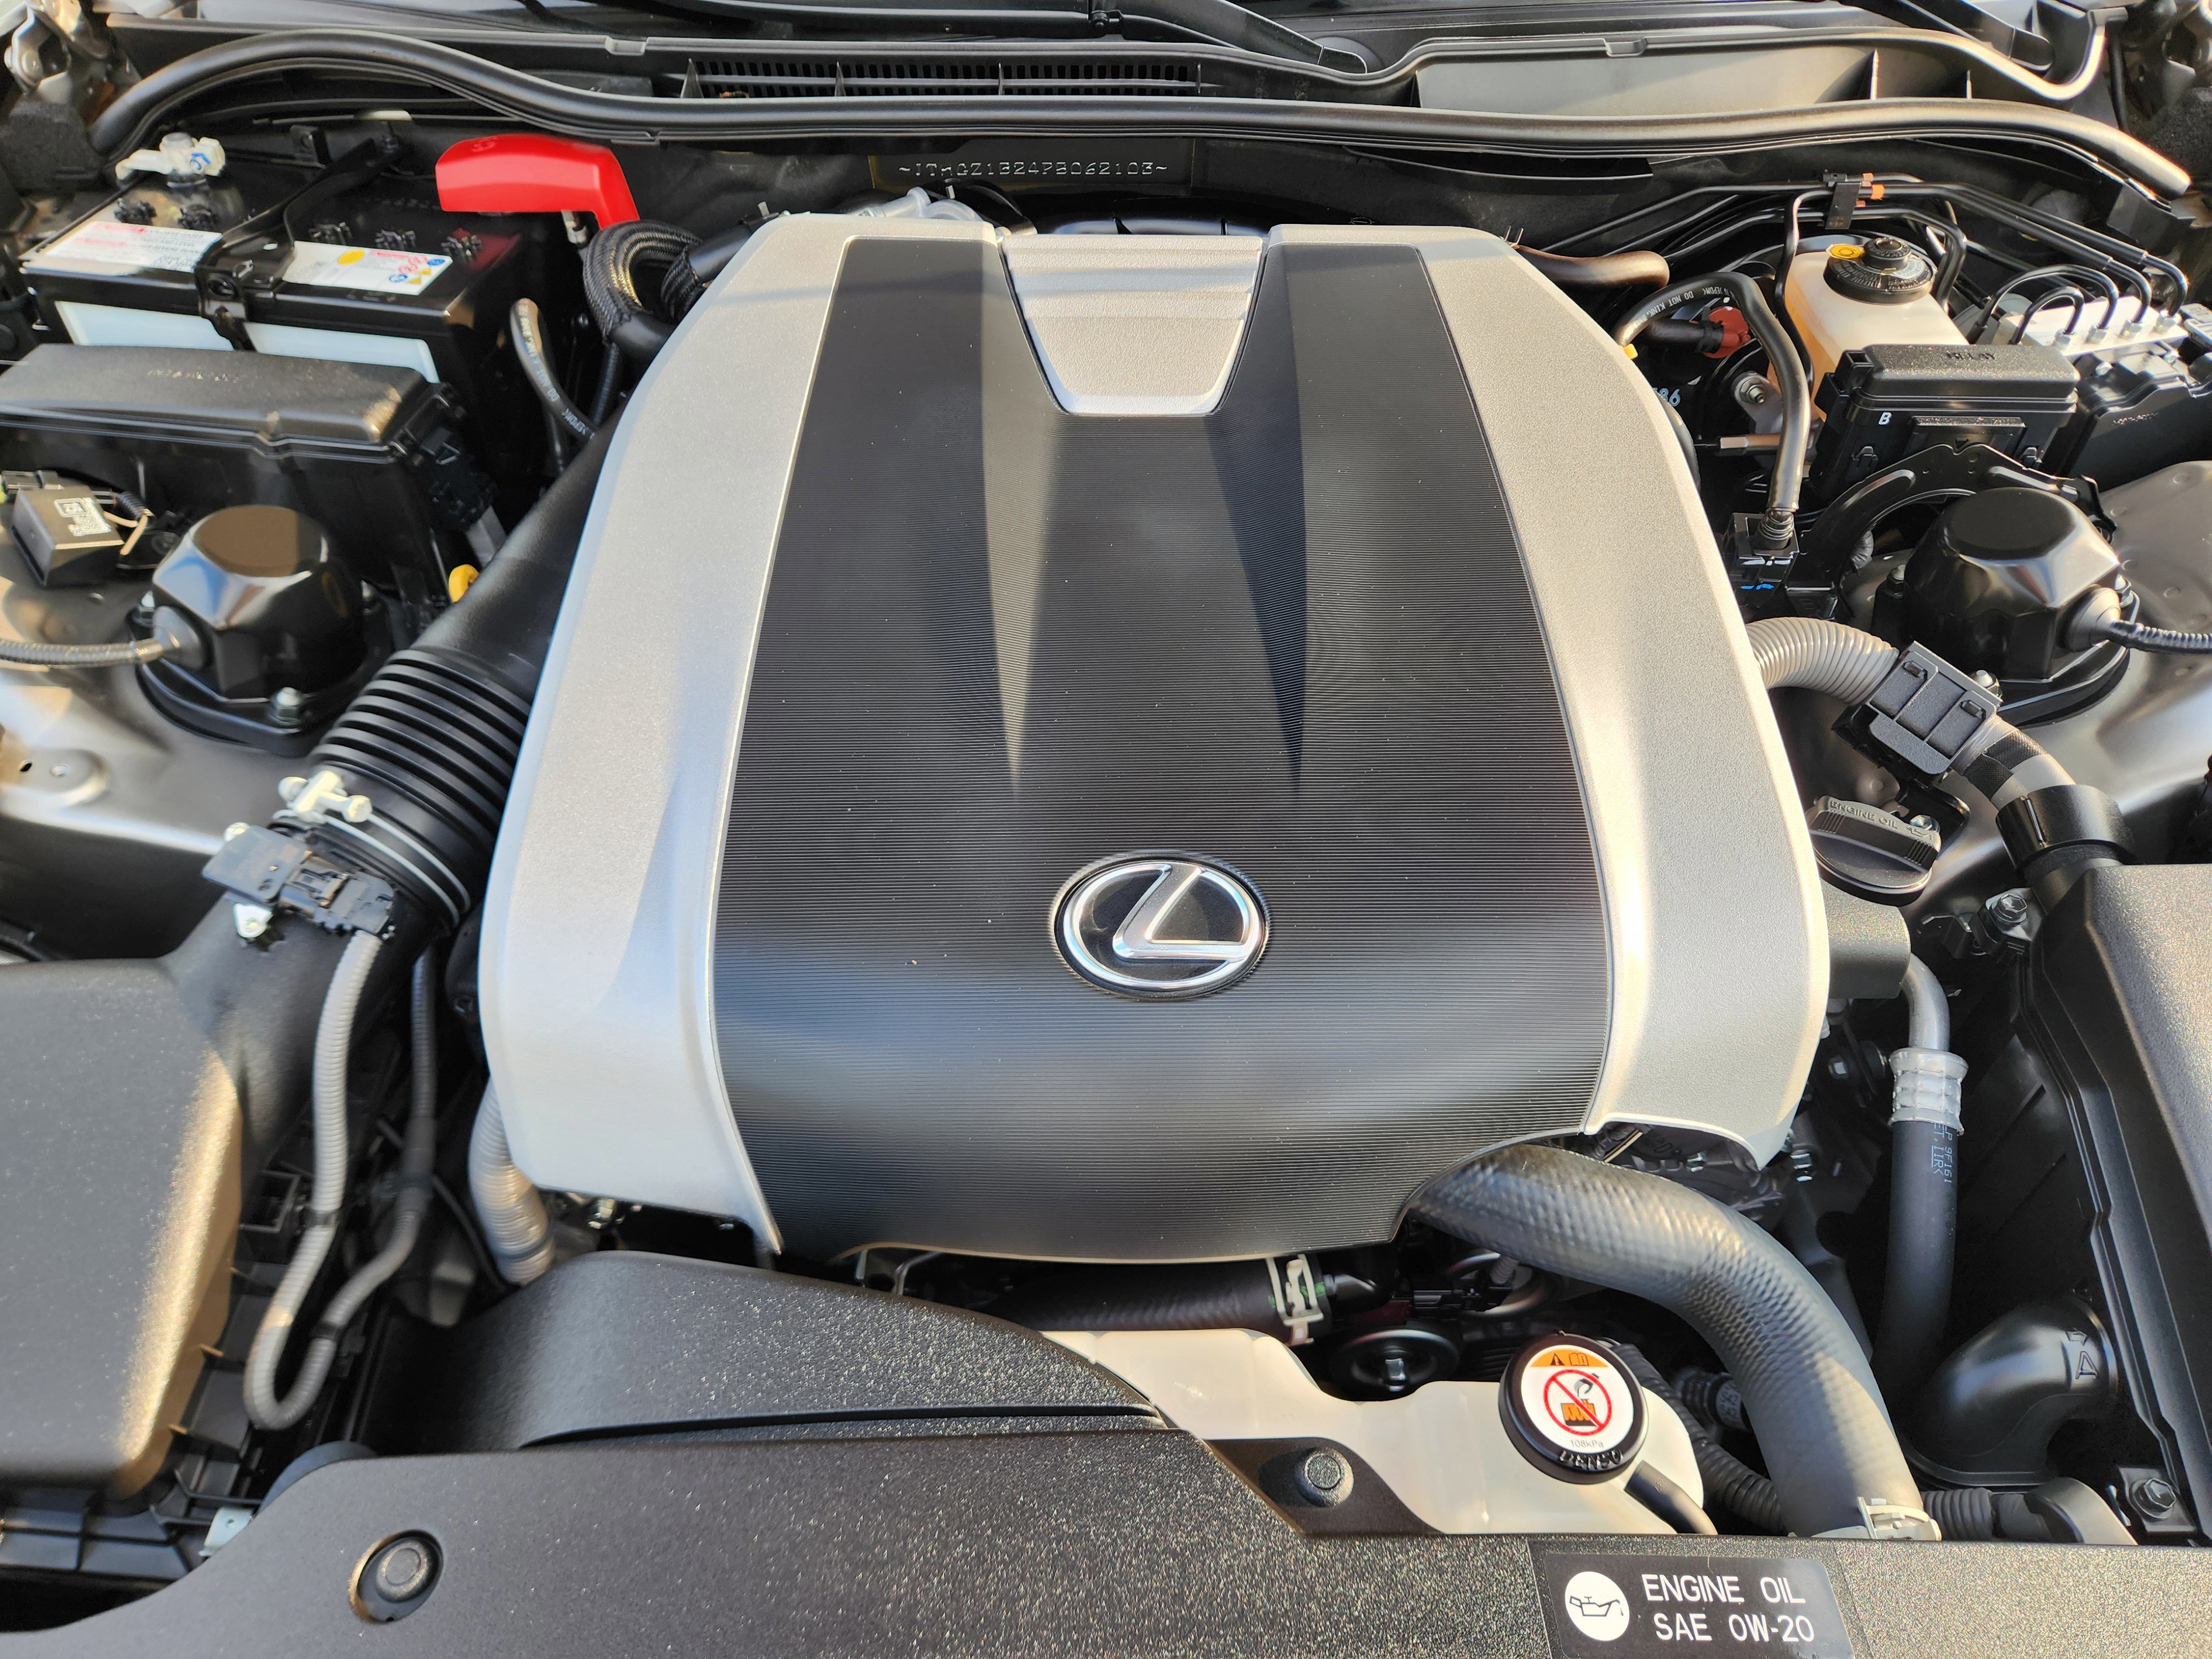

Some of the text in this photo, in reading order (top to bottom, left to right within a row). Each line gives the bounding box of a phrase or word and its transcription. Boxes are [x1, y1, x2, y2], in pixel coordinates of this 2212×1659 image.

[1668, 295, 1682, 306] NOT
[1684, 291, 1694, 300] DO
[1879, 413, 1892, 425] B
[1830, 800, 1898, 830] ENGINE OIL
[1641, 1574, 1806, 1603] ENGINE OIL
[1653, 1613, 1712, 1641] SAE
